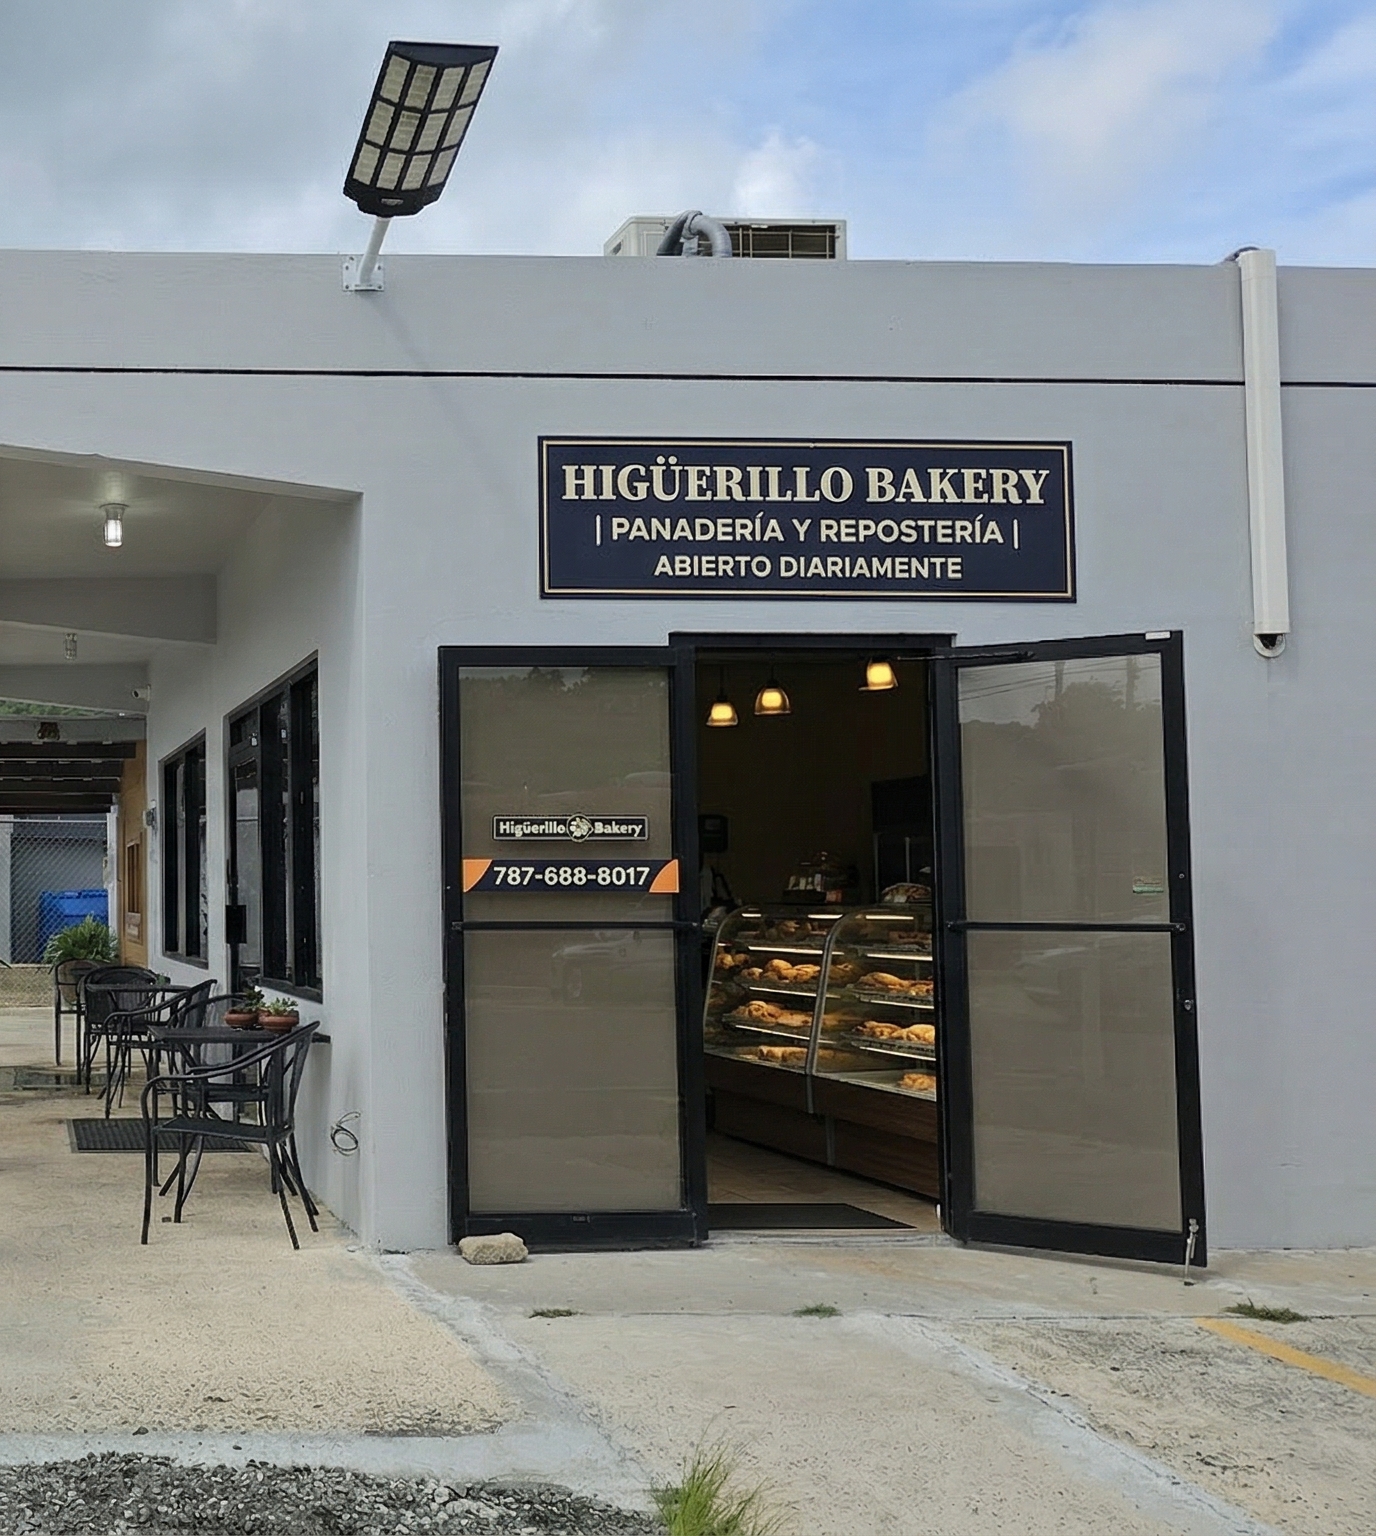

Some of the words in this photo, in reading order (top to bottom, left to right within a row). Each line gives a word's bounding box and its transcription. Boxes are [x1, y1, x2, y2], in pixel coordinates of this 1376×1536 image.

[561, 455, 853, 502] HIGÜERILLO
[865, 467, 1050, 504] BAKERY
[611, 512, 785, 542] PANADERÍA
[791, 518, 812, 542] Y
[820, 513, 1004, 544] REPOSTERÍA
[653, 555, 772, 578] ABIERTO
[779, 556, 962, 579] DIARIAMENTE
[594, 820, 643, 838] Bakery
[493, 866, 651, 886] 787-688-8017
